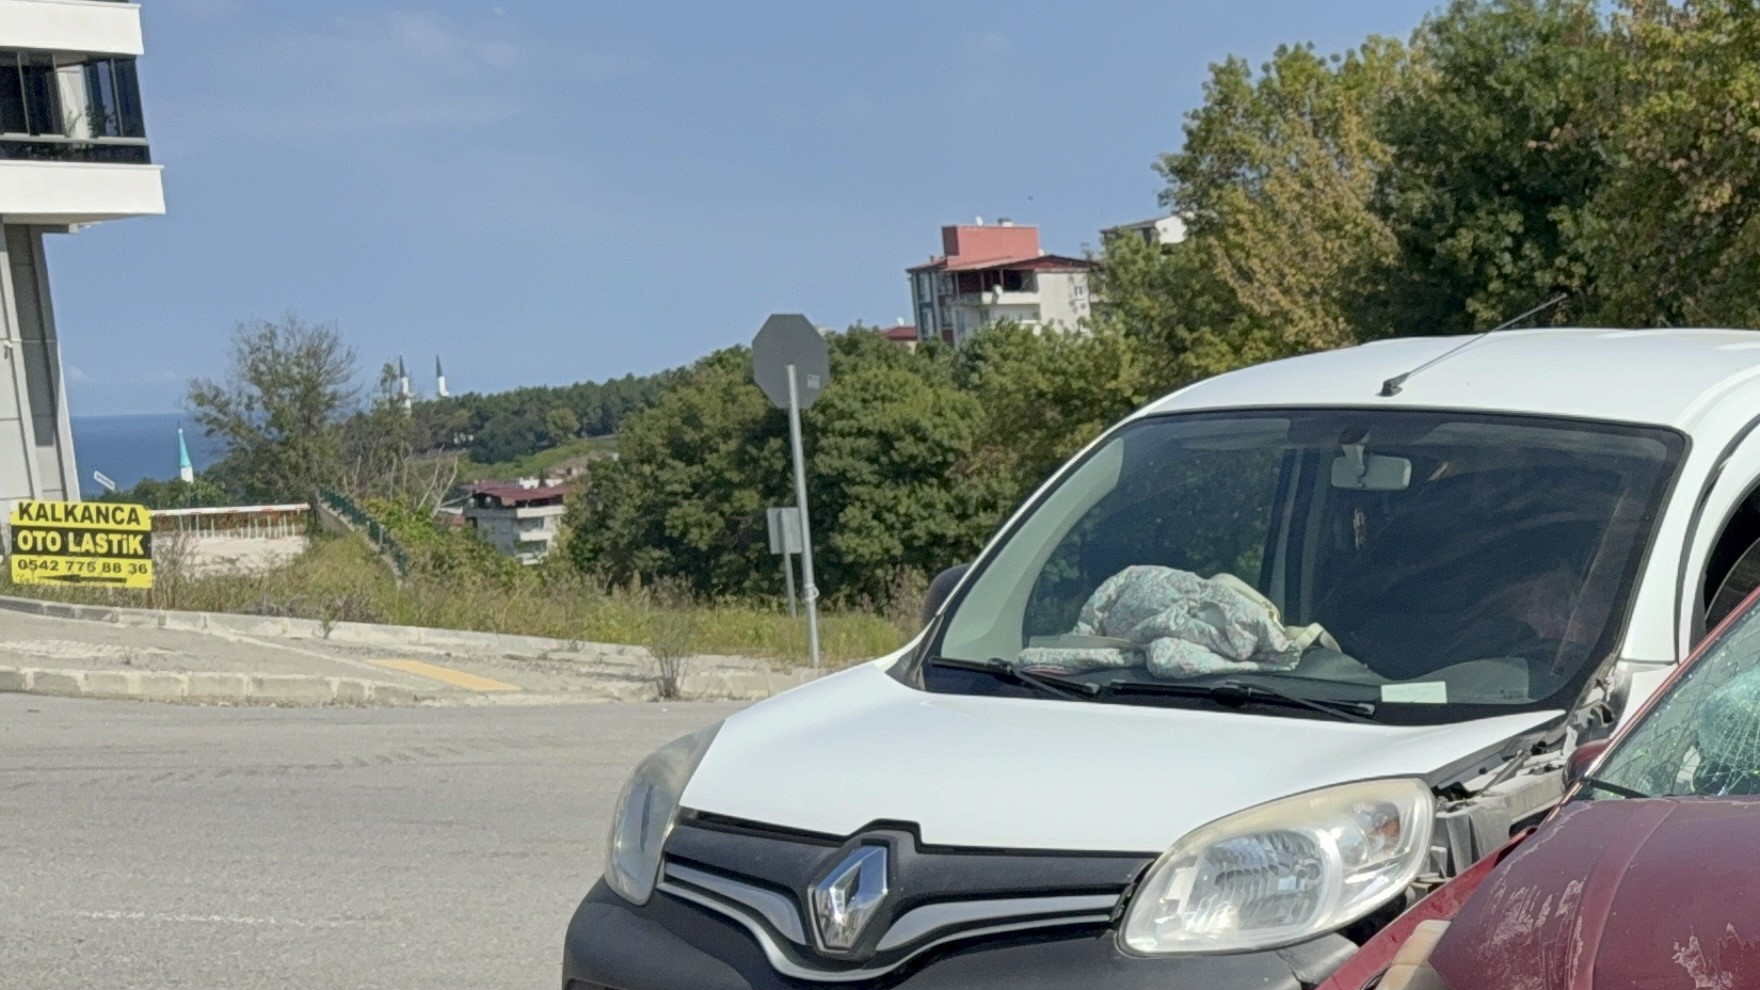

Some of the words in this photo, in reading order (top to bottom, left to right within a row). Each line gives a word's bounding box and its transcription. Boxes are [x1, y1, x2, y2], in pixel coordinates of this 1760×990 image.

[18, 501, 141, 526] KALKANCA
[17, 529, 62, 552] OTO
[17, 559, 60, 571] 0542
[102, 562, 123, 574] 88
[128, 563, 148, 575] 36
